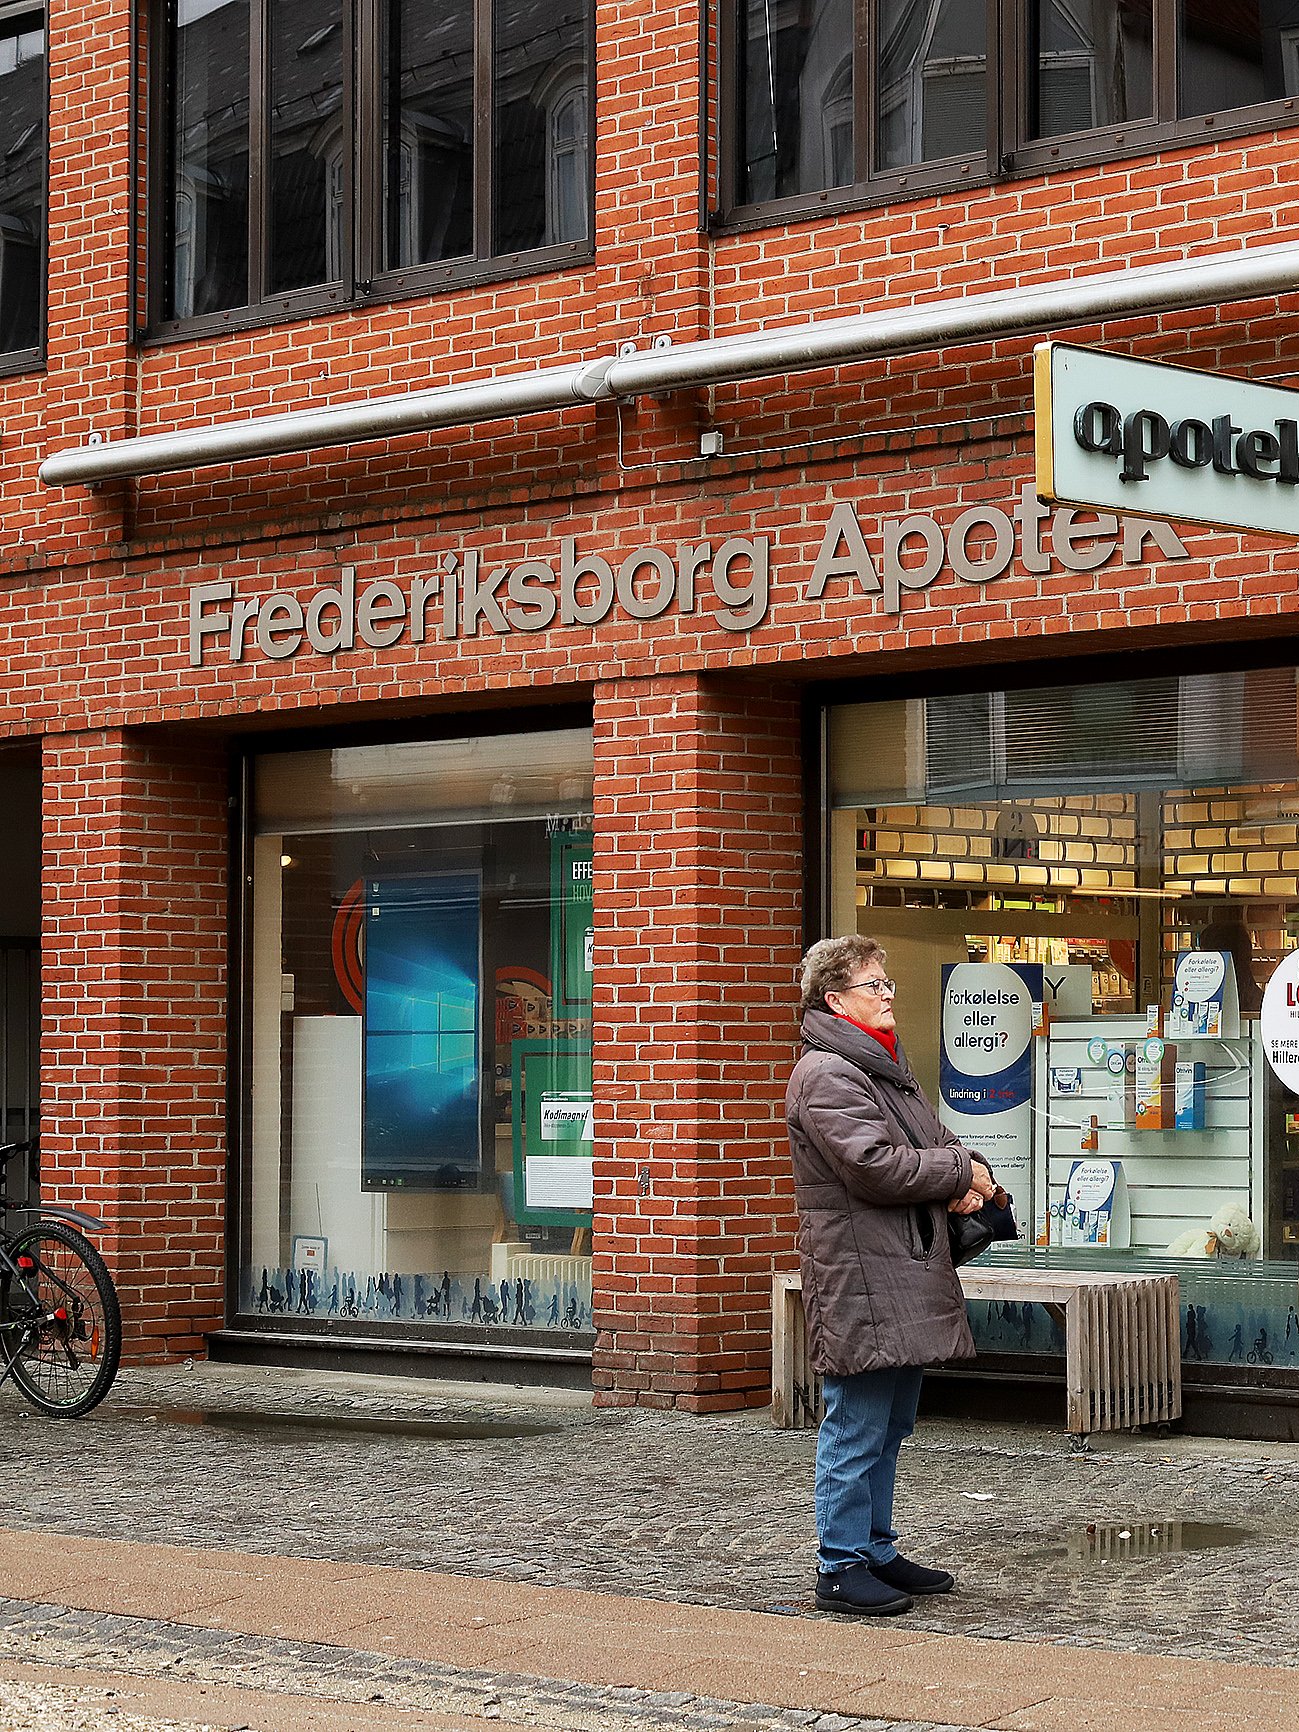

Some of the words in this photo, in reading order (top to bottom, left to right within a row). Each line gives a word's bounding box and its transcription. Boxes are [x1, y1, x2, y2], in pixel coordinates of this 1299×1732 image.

[189, 535, 770, 665] Frederiksborg
[950, 989, 1020, 1004] Forkølelse
[964, 1011, 996, 1026] eller
[954, 1032, 1008, 1052] allergi?
[1271, 1040, 1280, 1048] SE
[1281, 1040, 1298, 1048] MERE
[949, 1089, 980, 1101] Lindring
[544, 1109, 589, 1123] Kodimagnyl
